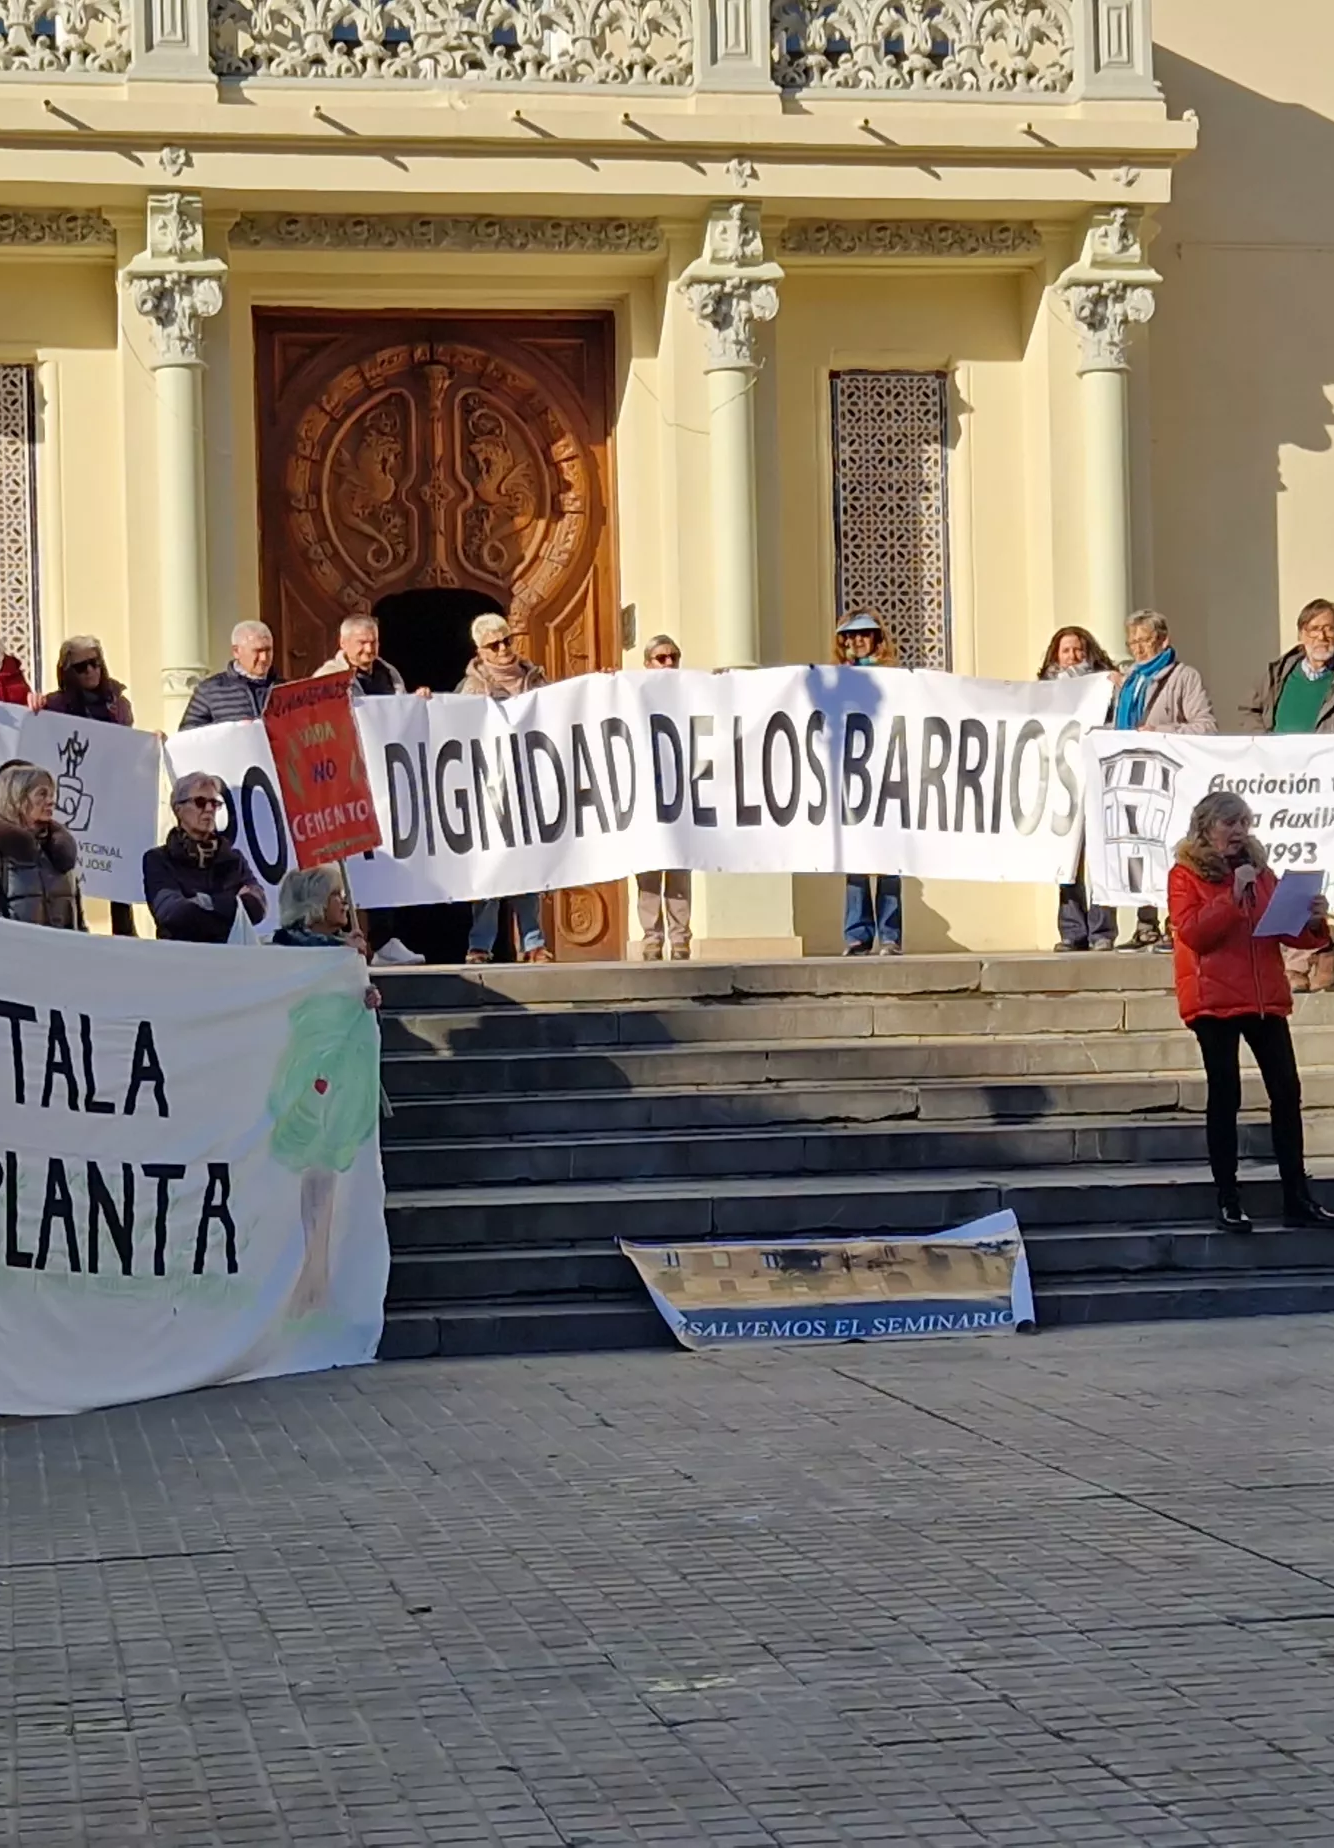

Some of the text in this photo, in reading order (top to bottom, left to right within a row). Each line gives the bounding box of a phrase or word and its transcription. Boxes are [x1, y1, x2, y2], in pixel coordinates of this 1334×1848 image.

[311, 758, 338, 783] NO
[384, 717, 636, 860] DIGNIDAD
[649, 714, 718, 827] DE
[733, 709, 827, 827] LOS
[841, 712, 1082, 837] BARRIOS
[1208, 772, 1321, 795] Asociación
[292, 800, 369, 843] CEMENTO
[78, 841, 123, 859] VECINAL
[1266, 842, 1318, 865] 1993
[833, 1319, 867, 1337] EL
[871, 1309, 1015, 1336] SEMINARIO
